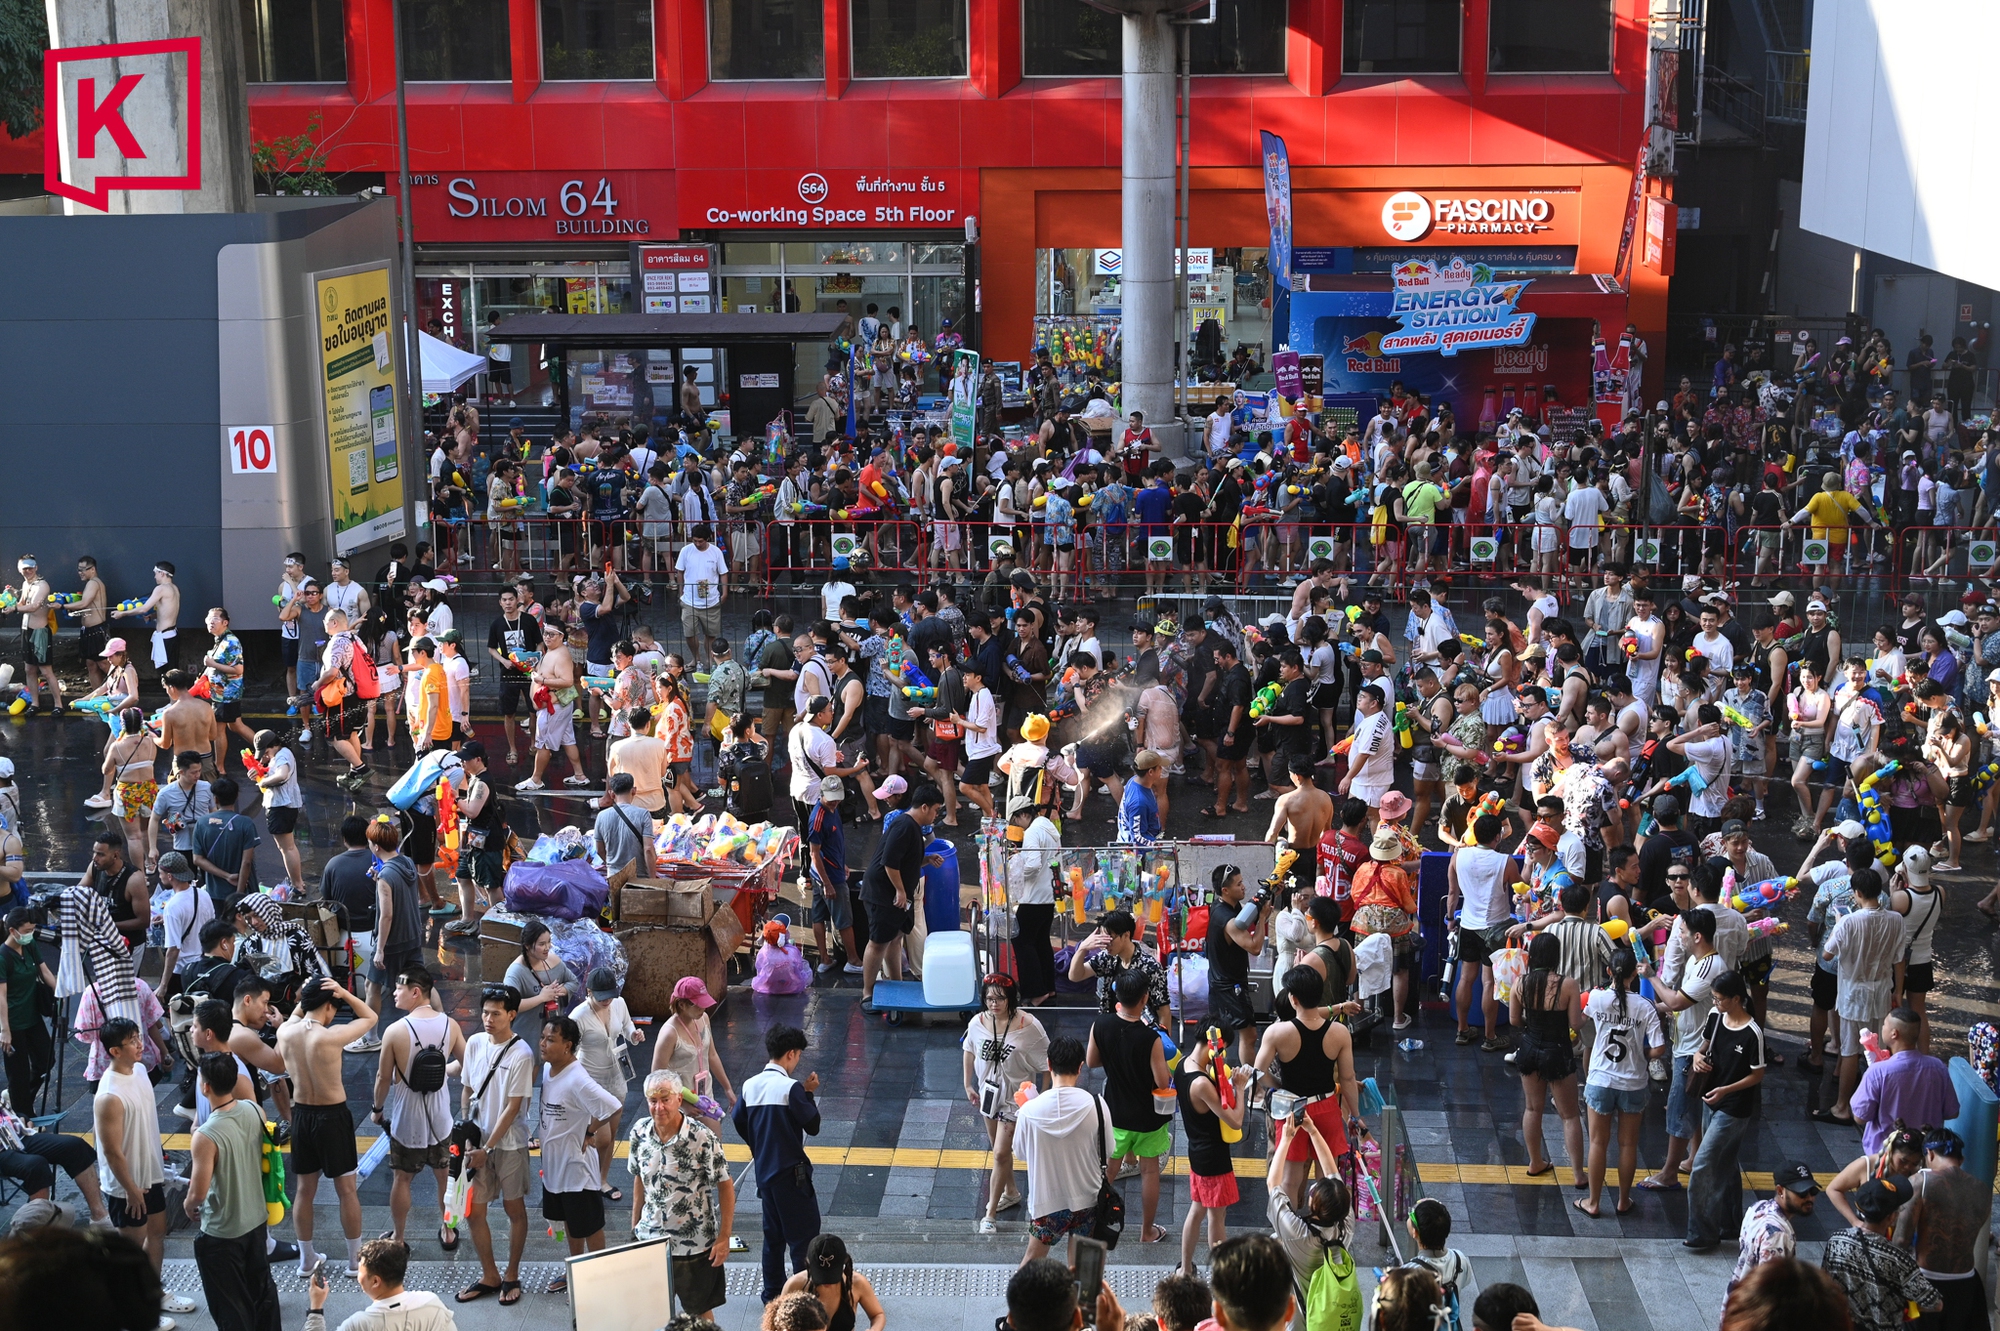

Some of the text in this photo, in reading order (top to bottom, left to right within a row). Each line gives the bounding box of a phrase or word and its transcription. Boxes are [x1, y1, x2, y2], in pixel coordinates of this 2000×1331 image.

[398, 174, 439, 185] าคาร
[856, 176, 945, 192] พื้นที่ทำงาน ชั้น 5
[801, 183, 825, 194] S64
[447, 176, 619, 218] SILOM 64
[706, 206, 955, 226] Co-working Space 5th Floor
[1435, 198, 1549, 222] FASCINO
[555, 219, 650, 234] BUILDING
[1447, 223, 1536, 234] PHARMACY
[648, 252, 705, 264] อาคารสีลม 64
[1525, 253, 1553, 265] คุ้มครบ
[1398, 277, 1430, 287] Red Bull
[1444, 269, 1471, 281] Ready
[650, 298, 672, 308] swing
[683, 298, 700, 306] swing
[1395, 286, 1499, 312] ENERGY
[344, 297, 387, 325] ติดตามผล
[1411, 307, 1499, 328] STATION
[325, 312, 388, 352] ขอใบอนุญาต
[1383, 318, 1528, 350] สาดพลัง สุดเอเนอร์จี้
[1347, 358, 1401, 373] Red Bull
[1494, 345, 1548, 371] Ready
[233, 429, 271, 470] 10
[1604, 1028, 1630, 1063] 5
